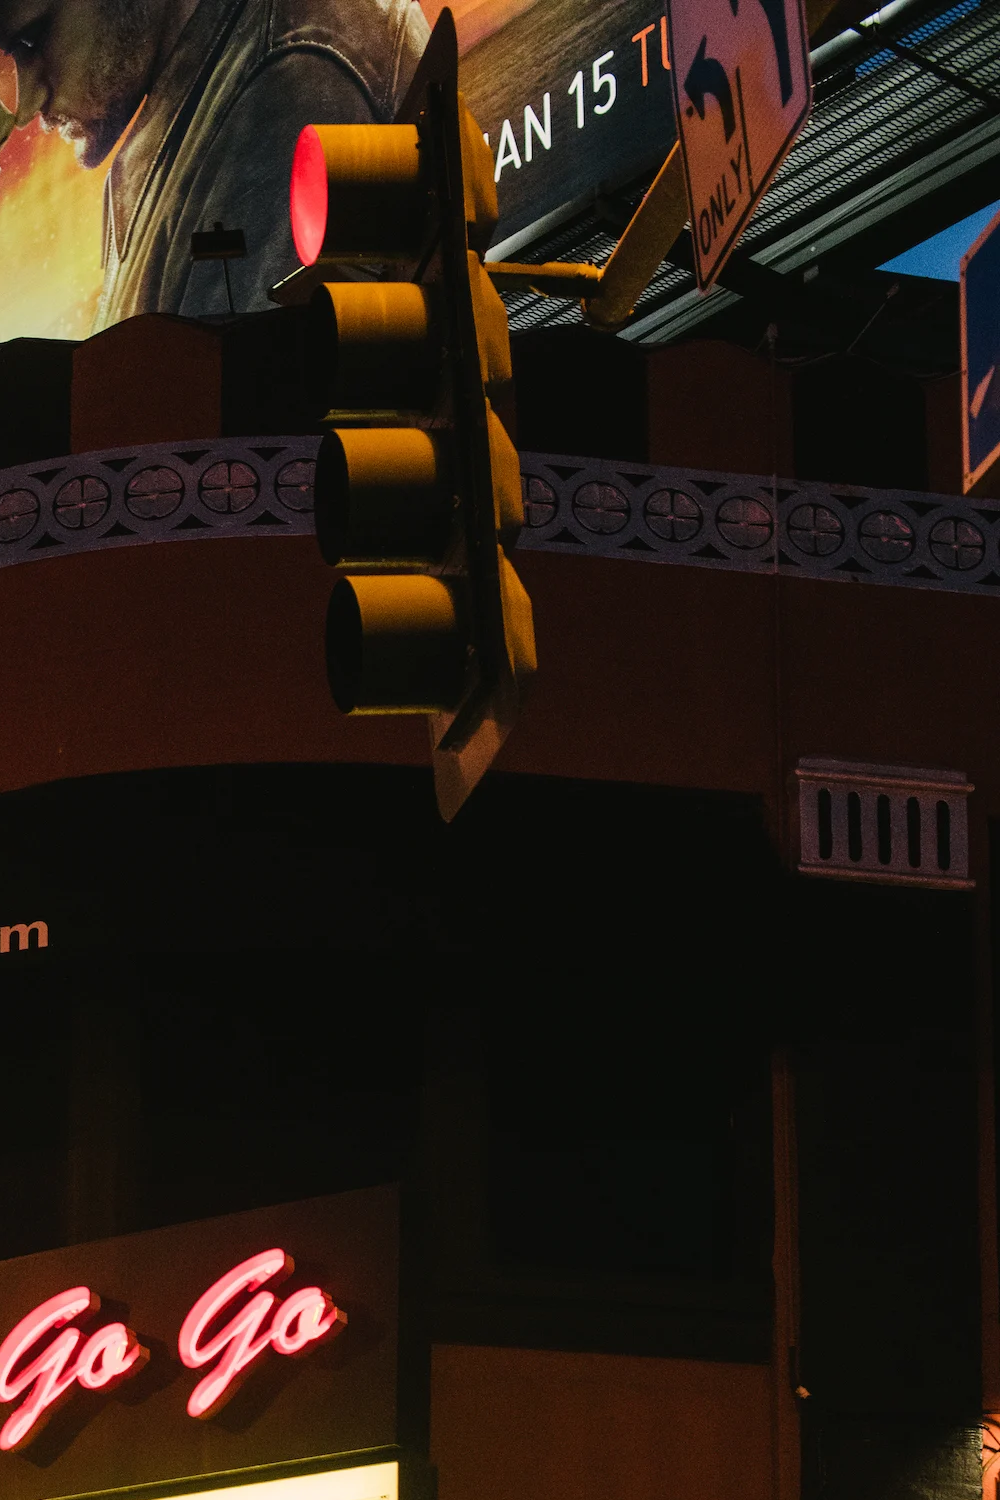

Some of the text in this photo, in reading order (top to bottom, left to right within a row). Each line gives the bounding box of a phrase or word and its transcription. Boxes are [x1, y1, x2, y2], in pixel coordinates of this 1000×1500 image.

[482, 91, 552, 183] AN
[567, 49, 617, 130] 15
[699, 143, 744, 257] ONLY
[178, 1247, 342, 1418] Go
